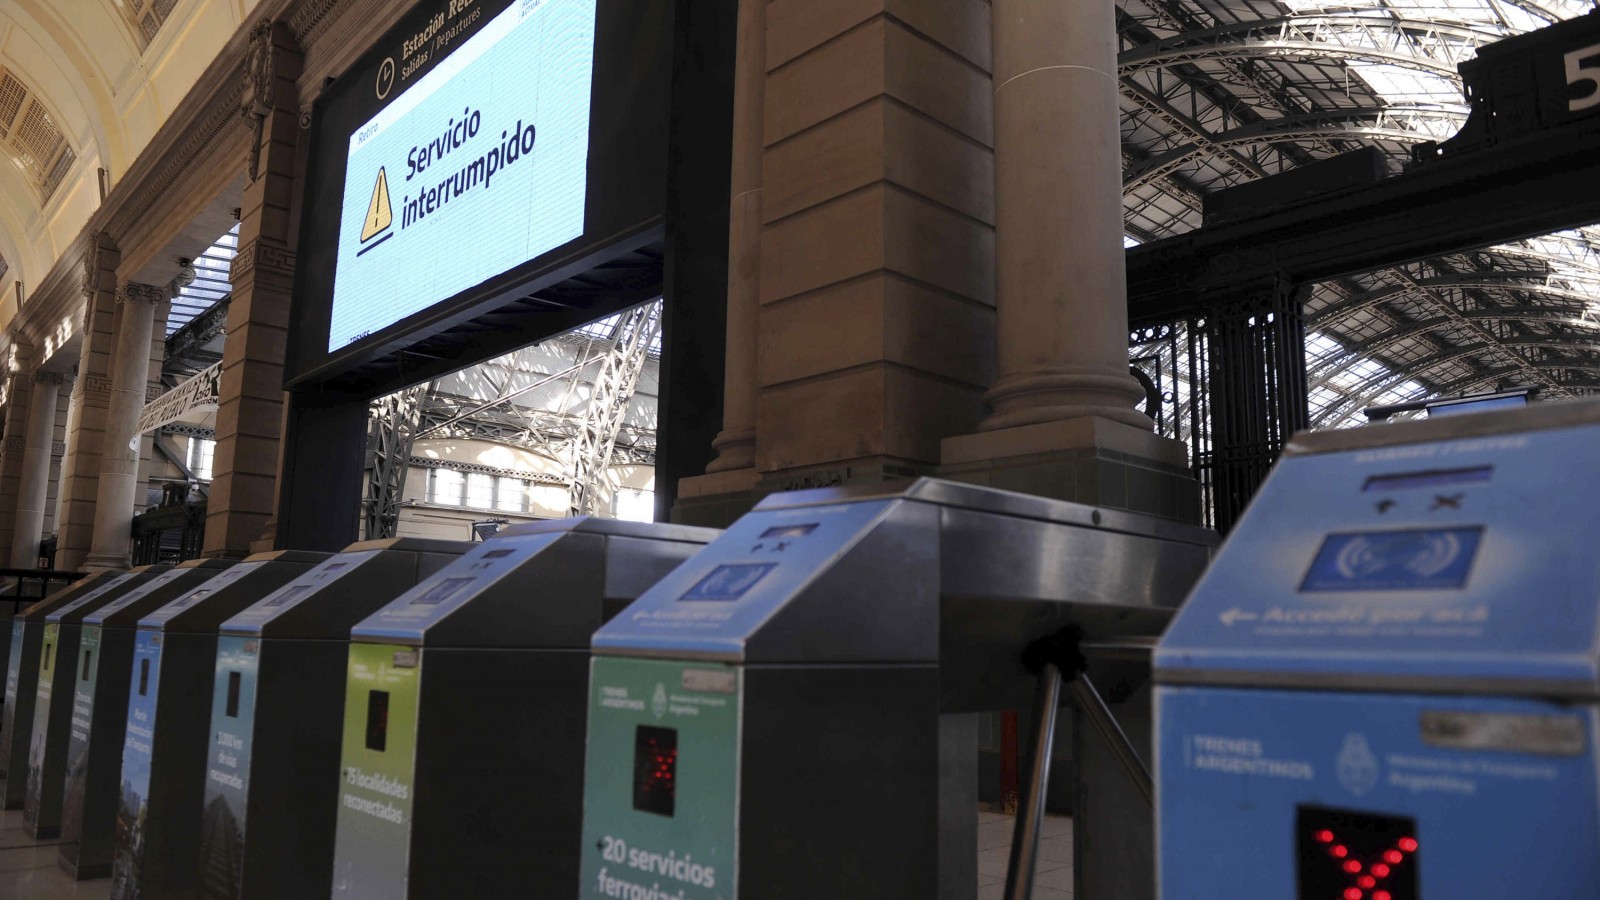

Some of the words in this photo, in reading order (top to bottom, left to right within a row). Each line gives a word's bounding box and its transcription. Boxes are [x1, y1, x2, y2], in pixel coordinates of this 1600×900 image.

[402, 12, 445, 60] Estación
[402, 51, 428, 80] Salidas
[436, 7, 481, 50] Departures
[1563, 43, 1600, 112] 5
[358, 122, 379, 145] Retiro
[406, 106, 481, 182] Servicio
[401, 119, 536, 230] interrumpido
[1194, 734, 1263, 757] TRENES
[1194, 754, 1314, 781] ARGENTINOS
[356, 766, 409, 799] localidades
[343, 793, 403, 824] reconectadas
[602, 834, 627, 864] 20
[628, 847, 716, 889] servicios
